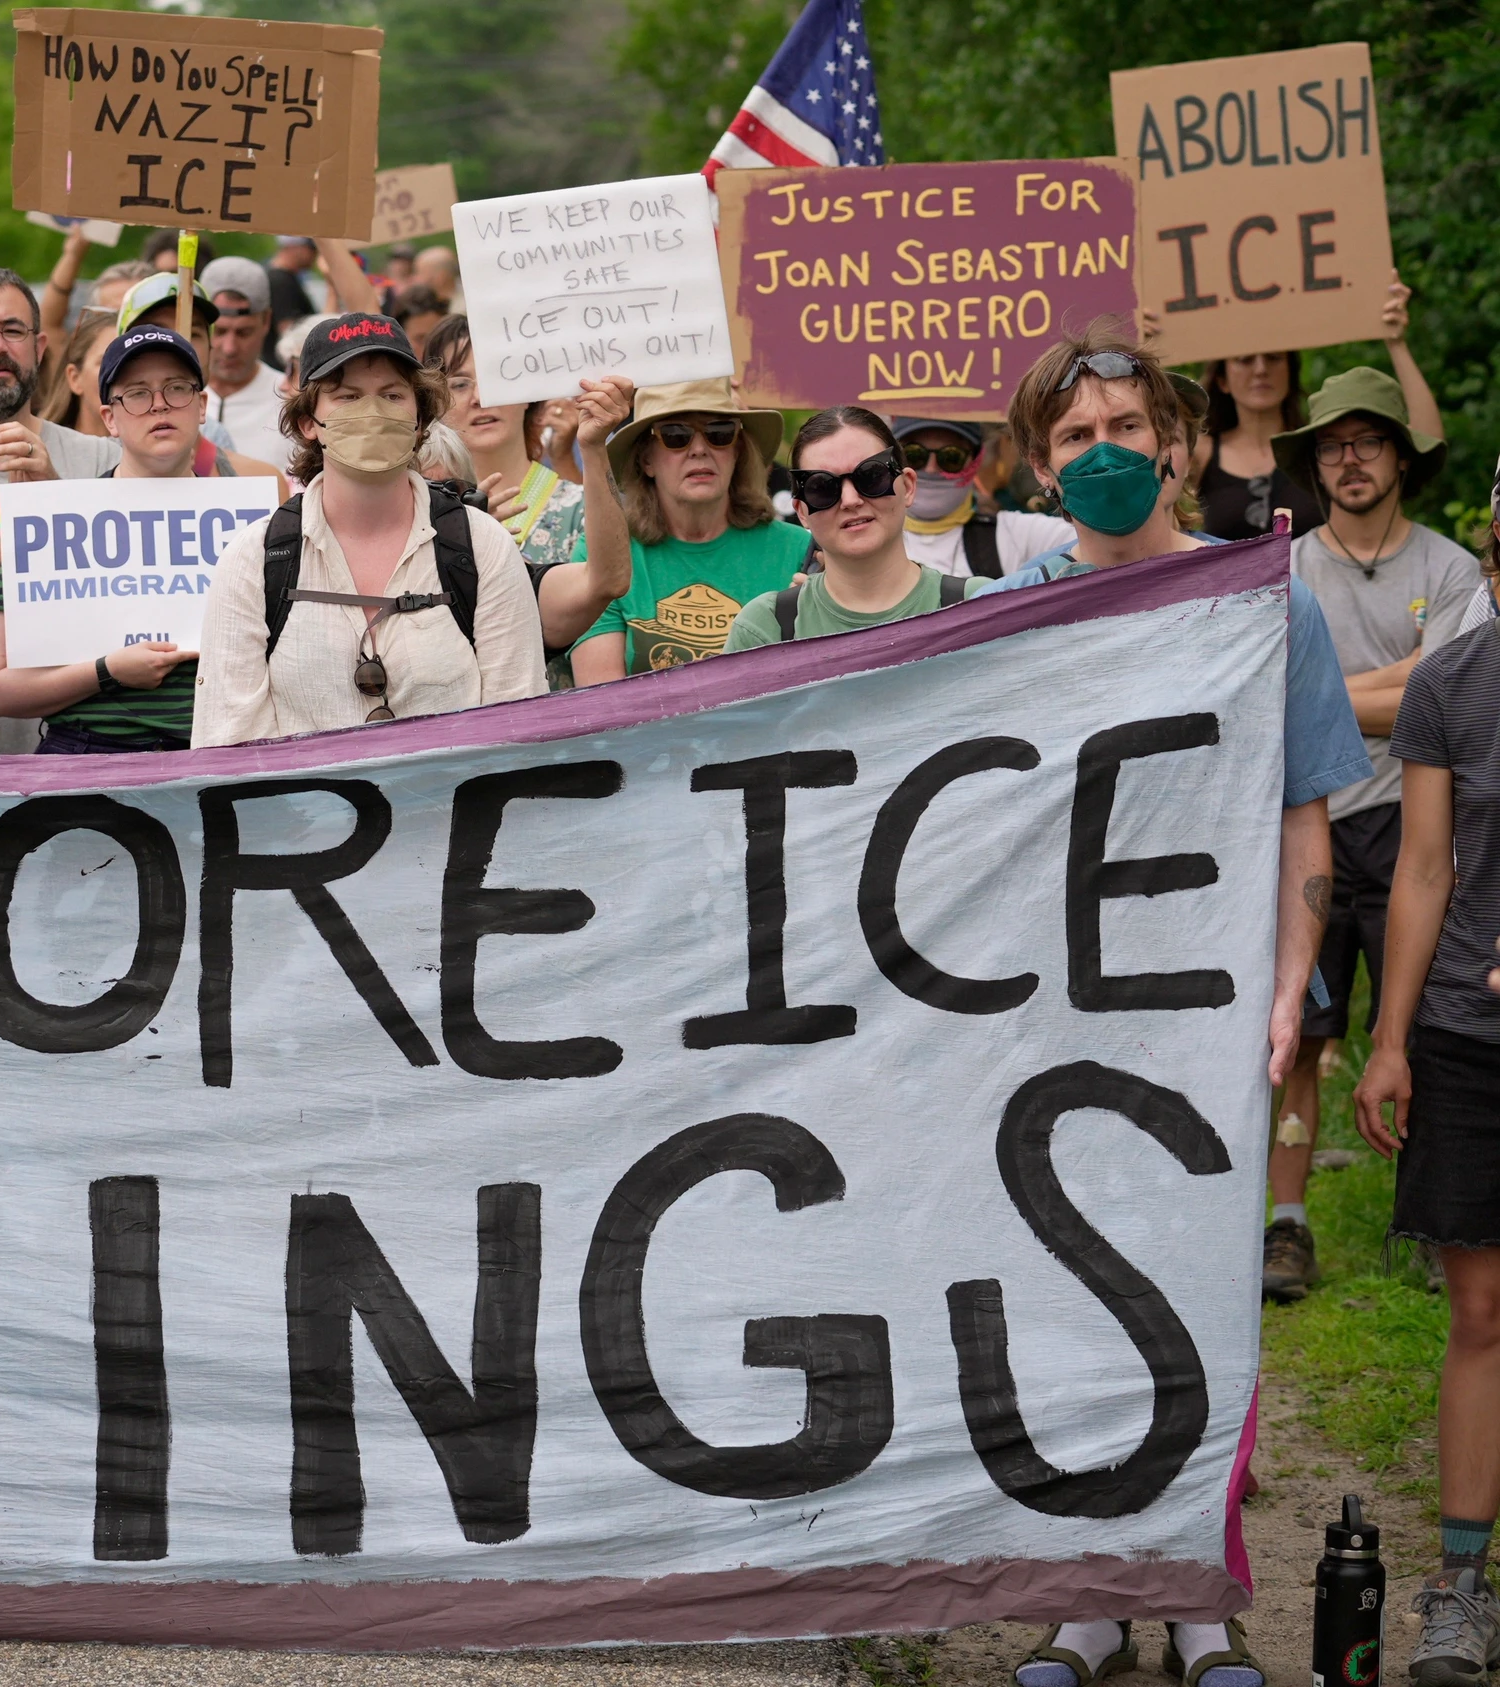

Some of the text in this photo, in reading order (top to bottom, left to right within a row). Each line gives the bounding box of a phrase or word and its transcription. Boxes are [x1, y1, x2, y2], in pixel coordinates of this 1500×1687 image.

[44, 35, 118, 82] HOW
[221, 55, 318, 107] SPELL
[94, 93, 313, 166] NAZI?
[1138, 76, 1370, 180] ABOLISH
[472, 193, 686, 240] WE KEEP OUR
[768, 173, 1101, 226] JUSTICE FOR
[497, 229, 684, 272] COMMUNITIES
[563, 262, 631, 290] SAFE
[753, 235, 1129, 294] JOAN SEBASTIAN
[1157, 210, 1353, 313] I.C.E.
[503, 290, 679, 342] ICE OUT!
[800, 290, 1052, 343] GUERRERO
[499, 325, 714, 381] COLLINS OUT!
[683, 713, 1234, 1050] ICE
